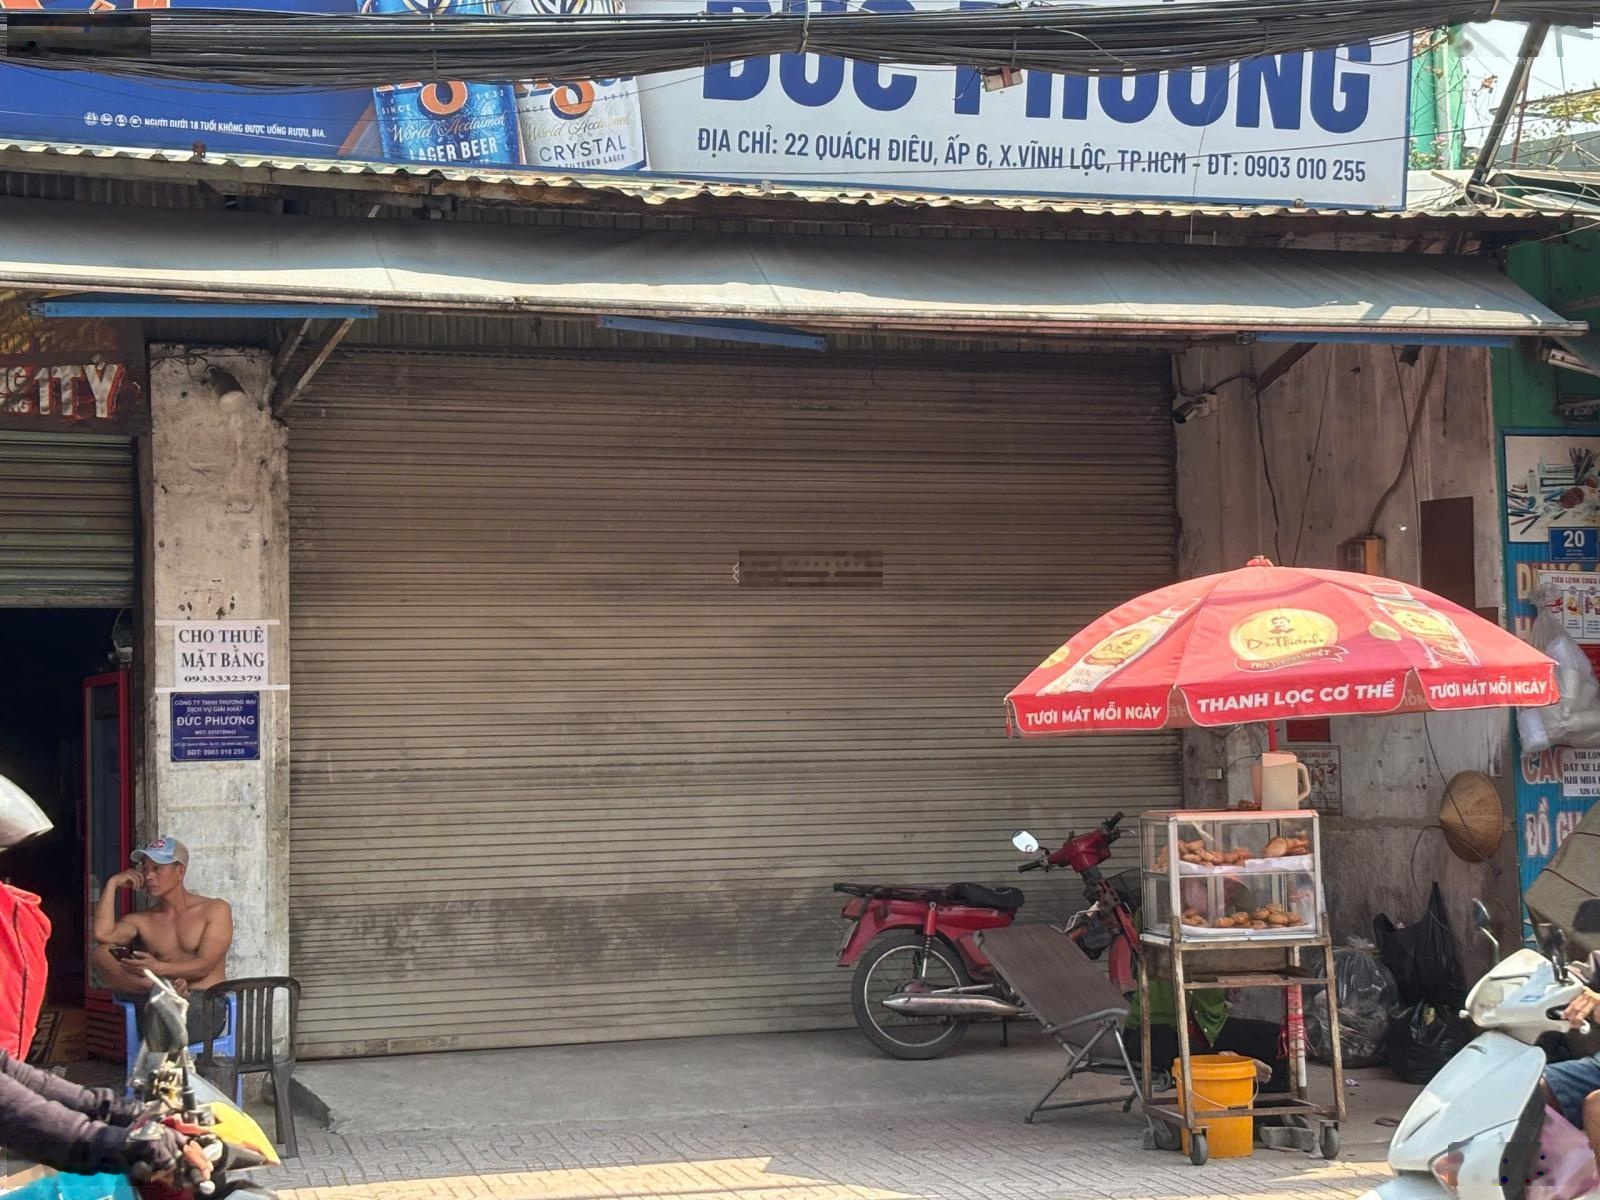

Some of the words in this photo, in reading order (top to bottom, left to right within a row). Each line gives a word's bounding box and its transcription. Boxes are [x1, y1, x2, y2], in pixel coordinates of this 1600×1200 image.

[190, 121, 199, 130] 18
[218, 120, 244, 133] KHÔNG
[245, 123, 265, 136] ĐƯỢC
[266, 122, 287, 135] UỐNG
[388, 121, 438, 143] World
[437, 116, 506, 137] Acclaimed
[526, 121, 566, 141] World
[410, 142, 461, 162] LAGER
[463, 137, 499, 159] BEER
[539, 134, 627, 163] CRYSTAL
[603, 154, 626, 164] LAGER
[697, 127, 731, 158] ĐỊA
[737, 124, 778, 155] CHỈ:
[785, 132, 809, 157] 22
[815, 129, 881, 161] QUÁCH
[888, 134, 938, 166] ĐIÊU,
[944, 134, 971, 165] ẤP
[976, 147, 993, 168] 6,
[999, 139, 1063, 170] X.VĨNH
[1069, 142, 1110, 176] LỘC,
[1117, 149, 1186, 174] TP.HCM
[1207, 152, 1238, 176] ĐT:
[1244, 154, 1290, 179] 0903
[1296, 157, 1326, 181] 010
[1333, 159, 1366, 182] 255
[1562, 530, 1585, 548] 20
[178, 629, 214, 644] CHO
[218, 625, 264, 644] THUÊ
[181, 649, 217, 671] MẶT
[221, 645, 265, 669] BẰNG
[1197, 692, 1268, 713] THANH
[1274, 688, 1314, 708] LỌC
[1319, 684, 1350, 701] CƠ
[1355, 678, 1396, 699] THỂ
[1429, 683, 1460, 699] TƯƠI
[1462, 679, 1488, 696] MÁT
[1489, 675, 1511, 694] MỖI
[1514, 678, 1547, 695] NGÀY
[176, 714, 201, 727] ĐỨC
[204, 714, 255, 726] PHƯƠNG
[1026, 711, 1057, 726] TƯƠI
[1062, 706, 1091, 723] MÁT
[1093, 701, 1121, 721] MỖI
[1125, 703, 1161, 720] NGÀY
[1579, 762, 1591, 772] XE
